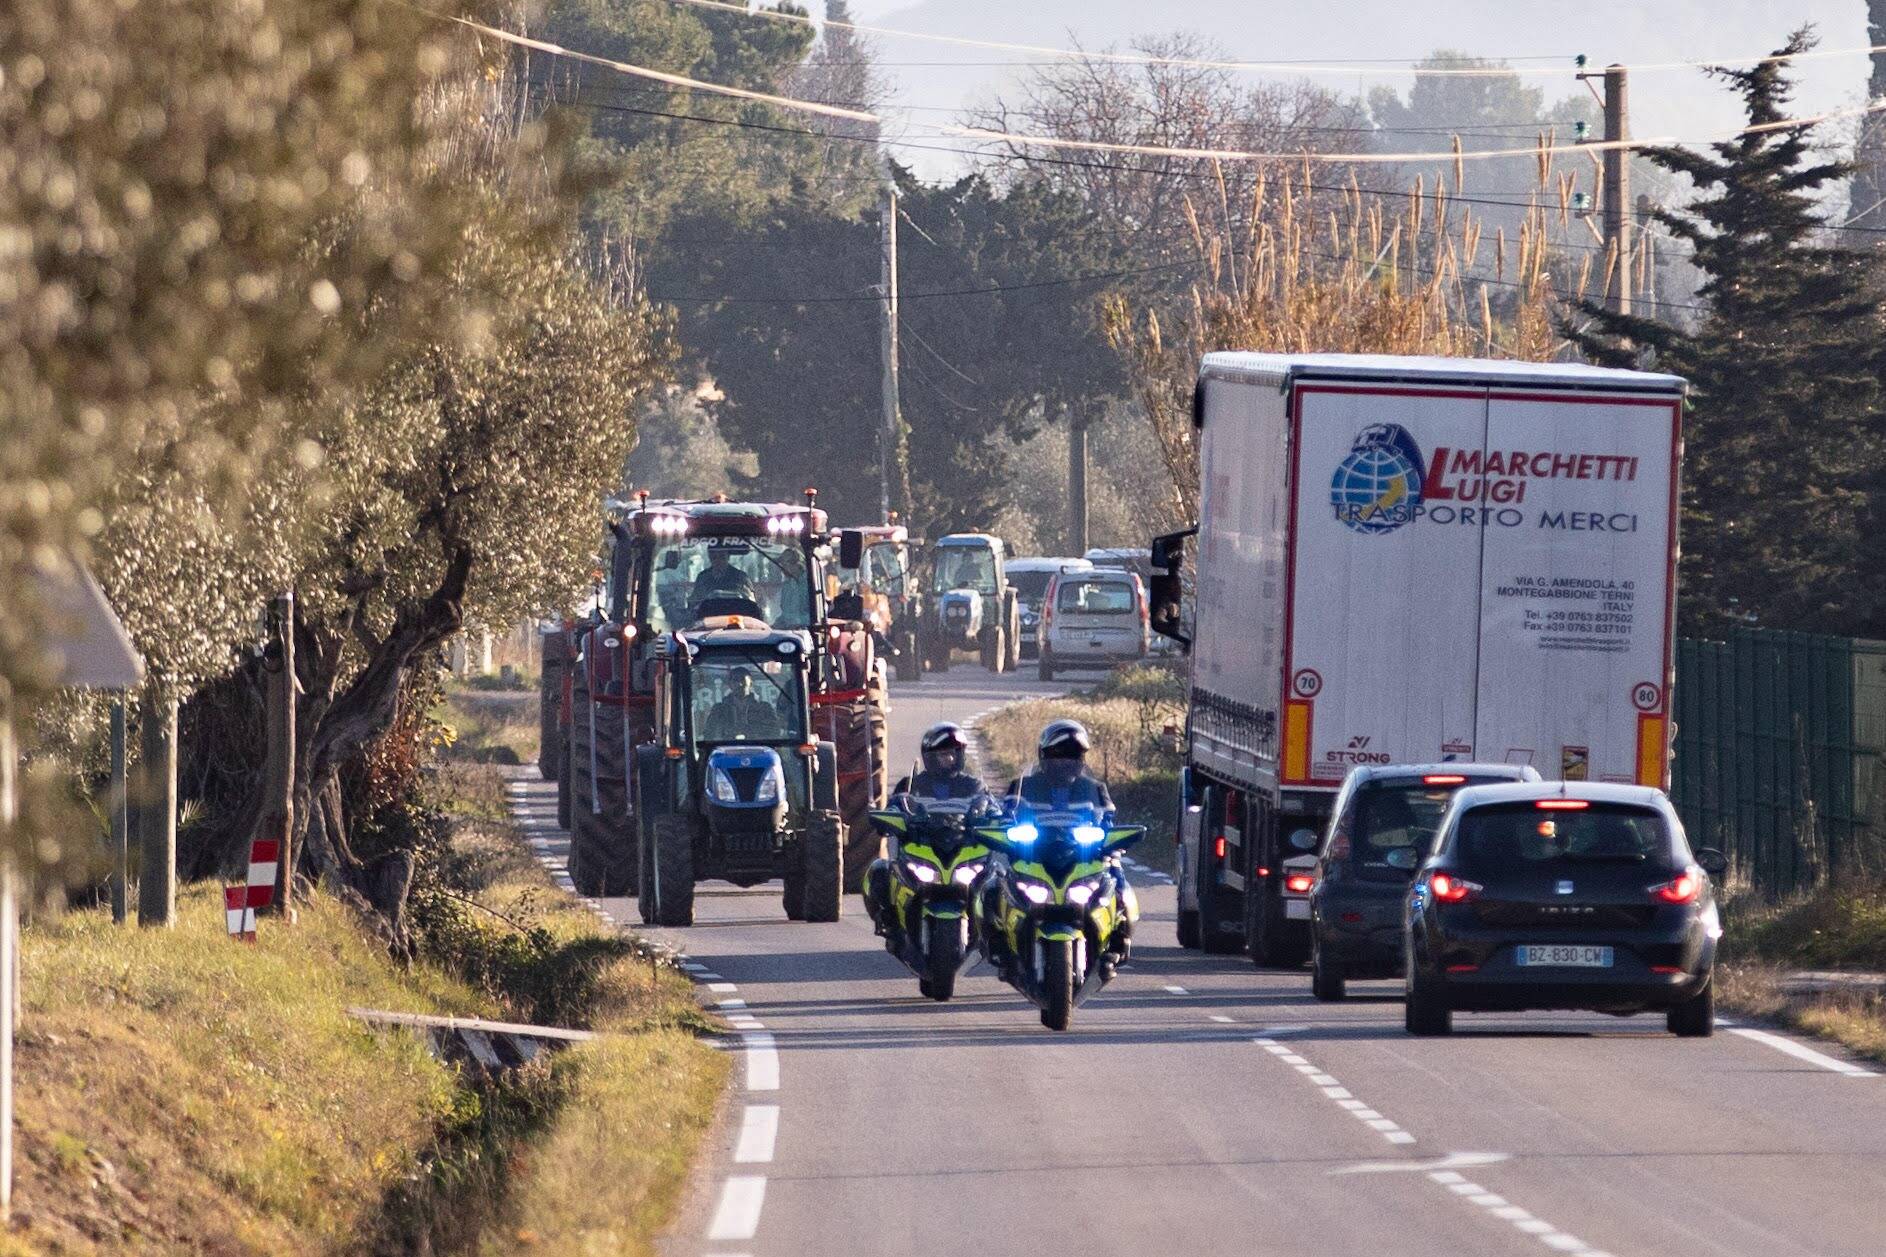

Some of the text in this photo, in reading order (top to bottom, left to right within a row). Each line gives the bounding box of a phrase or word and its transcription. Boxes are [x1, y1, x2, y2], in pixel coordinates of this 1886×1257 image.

[1450, 449, 1639, 481] MARCHETTI
[1422, 447, 1527, 504] LUIGI
[1330, 502, 1638, 533] TRASPORTO MERCI
[1515, 576, 1534, 586] VIA
[1537, 577, 1549, 587] G.
[1622, 581, 1635, 590] 40
[1497, 586, 1634, 601] MONTEGABBIONE TERNI
[1603, 602, 1634, 612] ITALY
[1525, 610, 1542, 620] Tel.
[1546, 611, 1565, 621] +39
[1568, 612, 1592, 622] 0763
[1524, 621, 1543, 631] Fax
[1546, 622, 1565, 632] +39
[1567, 623, 1592, 633] 0763
[1301, 676, 1316, 690] 70
[1639, 689, 1655, 703] 80
[1326, 751, 1391, 764] STRONG
